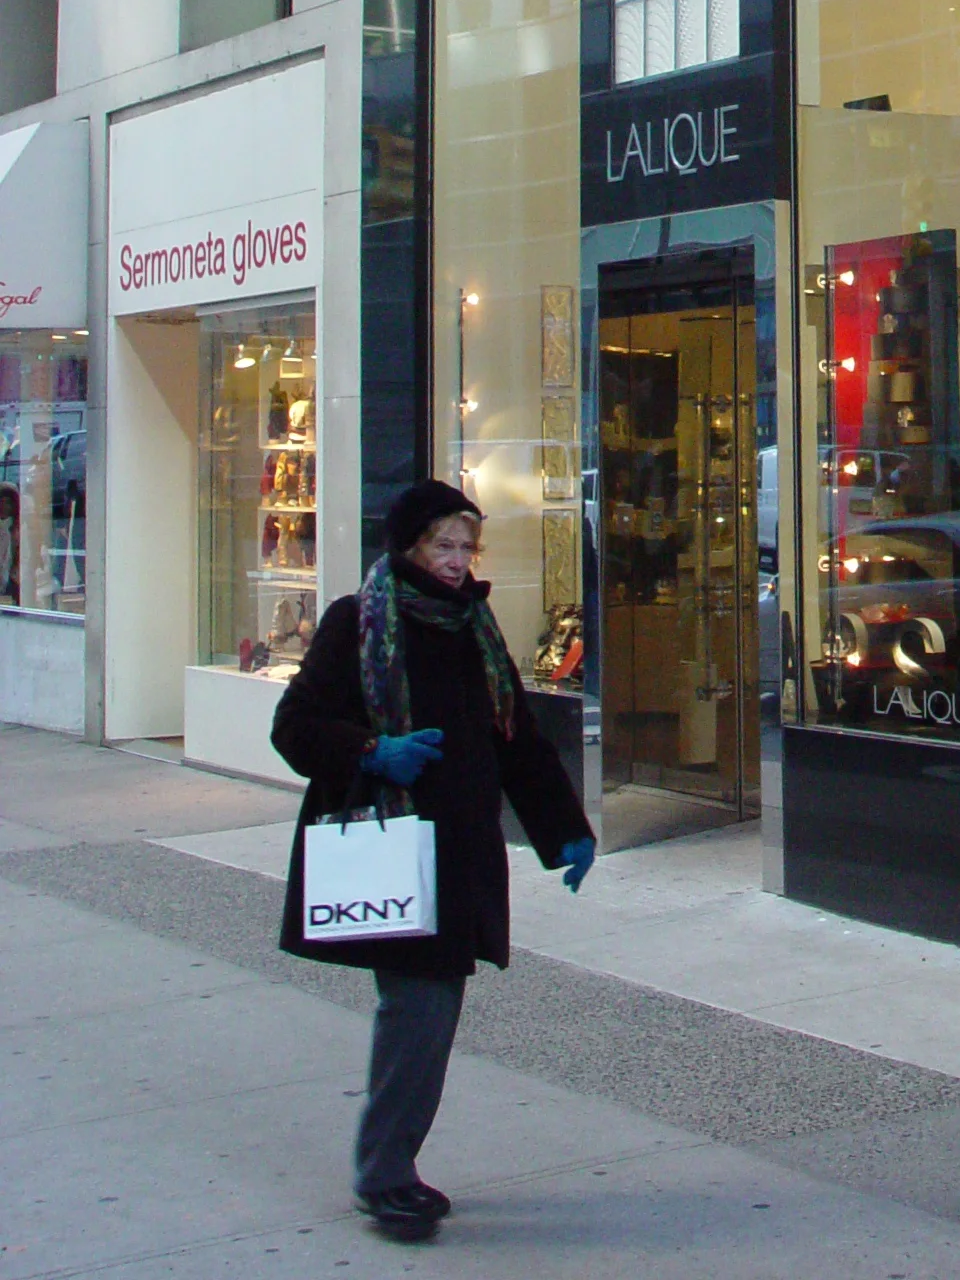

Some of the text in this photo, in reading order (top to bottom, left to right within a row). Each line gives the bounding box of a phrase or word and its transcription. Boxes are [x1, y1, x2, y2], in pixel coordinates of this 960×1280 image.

[606, 104, 740, 182] LALIQUE
[119, 219, 307, 292] Sermoneta gloves
[0, 281, 43, 318] gal
[309, 896, 415, 926] DKNY
